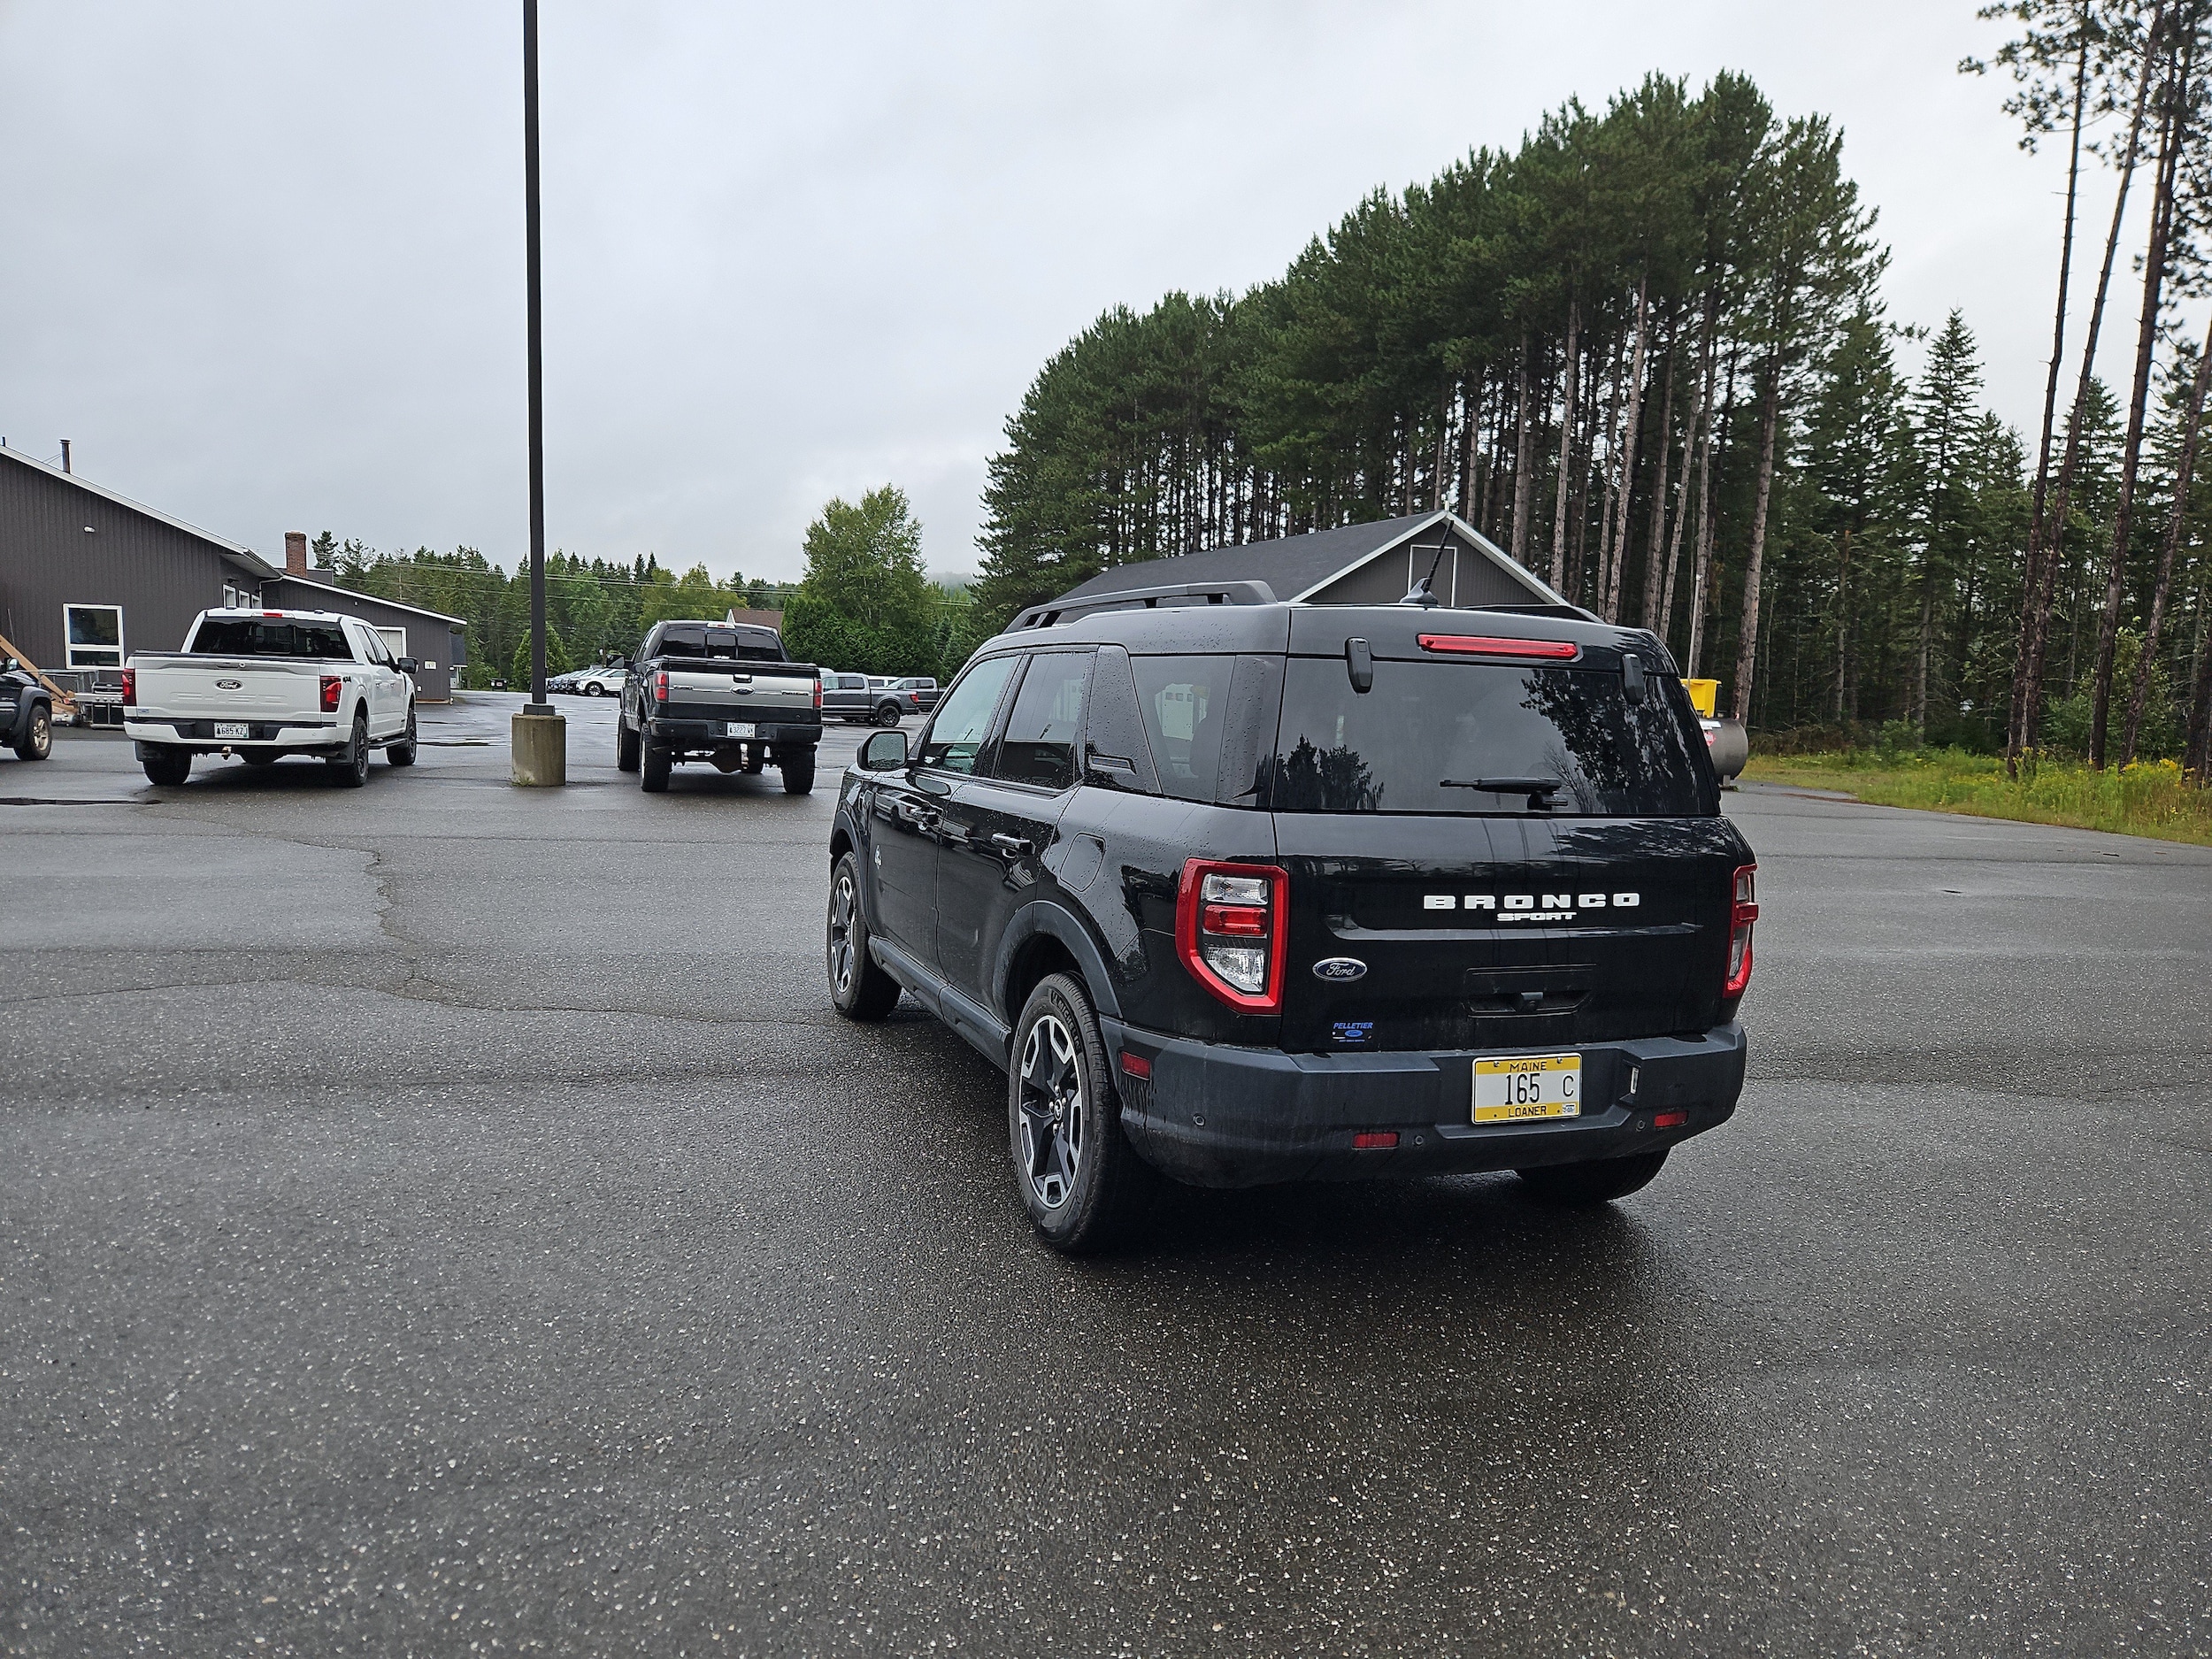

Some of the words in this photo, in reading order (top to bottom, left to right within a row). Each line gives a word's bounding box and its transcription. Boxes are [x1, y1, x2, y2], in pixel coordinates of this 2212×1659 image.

[1424, 893, 1640, 910] BRONCO
[1497, 912, 1577, 921] SPORT
[1325, 962, 1356, 977] Ford
[1509, 1061, 1548, 1071] MAINE
[1504, 1073, 1540, 1105] 165
[1563, 1075, 1574, 1097] C
[1508, 1105, 1547, 1118] LOANER
